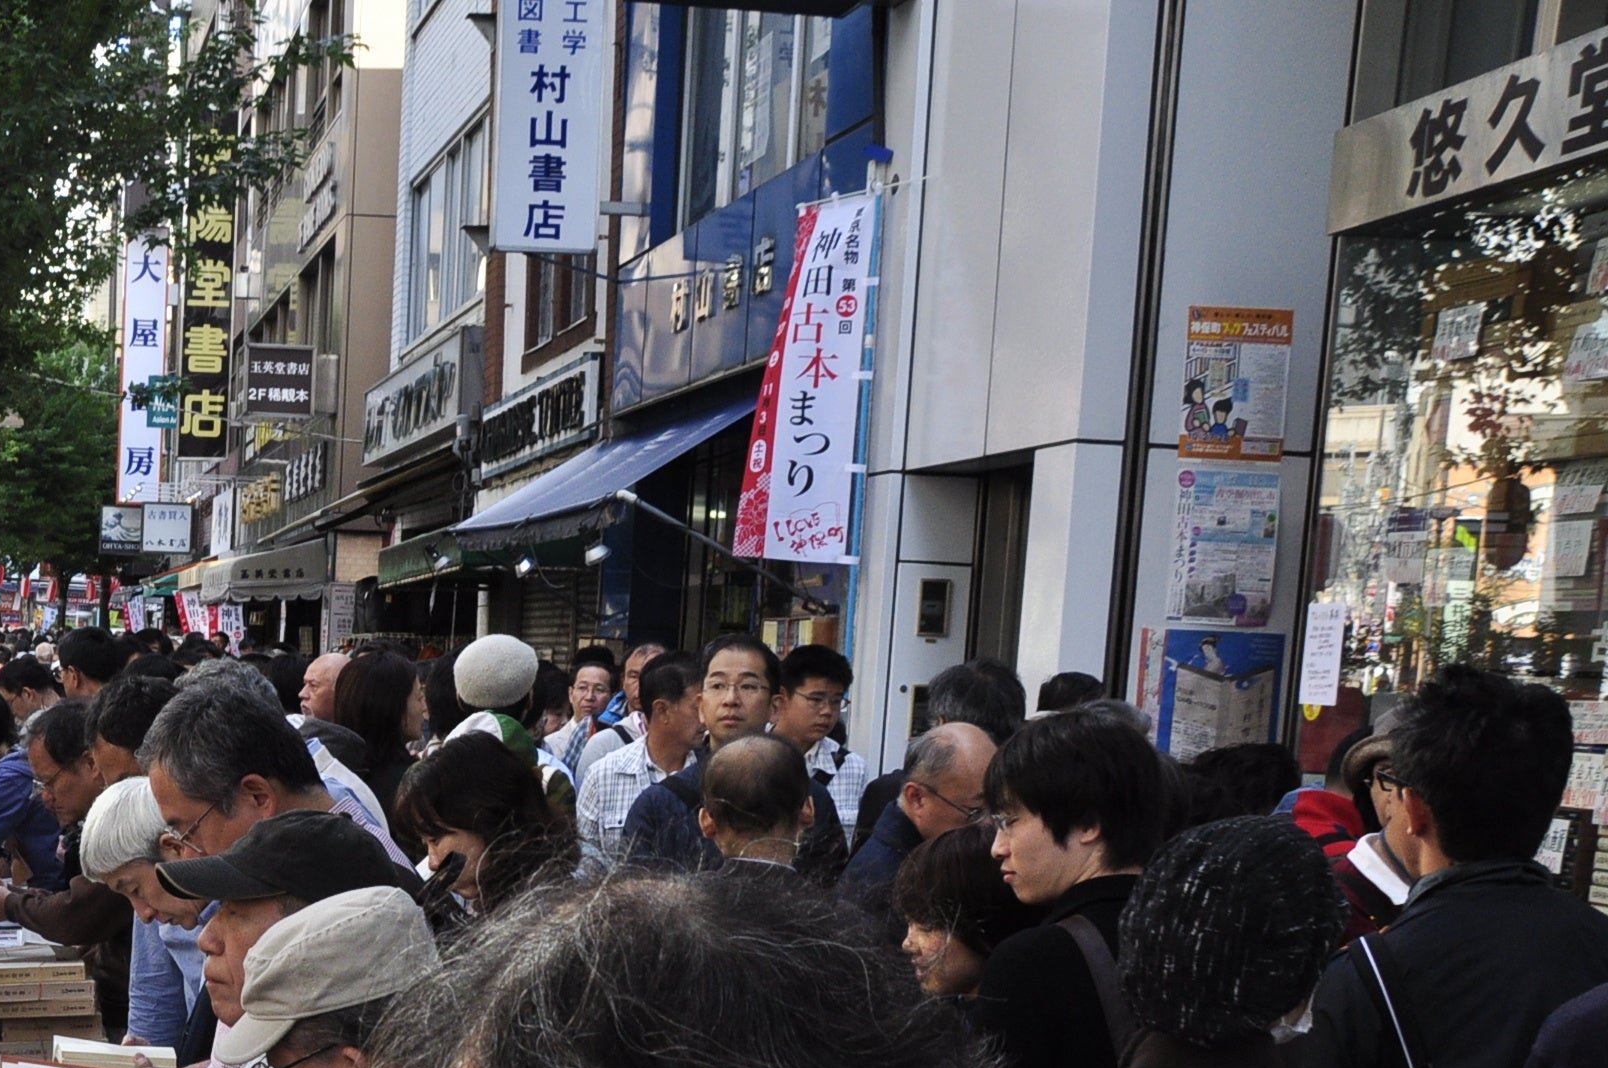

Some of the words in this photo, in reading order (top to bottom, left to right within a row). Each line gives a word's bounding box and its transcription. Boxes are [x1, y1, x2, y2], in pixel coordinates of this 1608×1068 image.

[516, 0, 543, 54] 図書
[524, 63, 570, 240] 村山書店
[250, 361, 310, 376] 玉英堂書店
[787, 227, 841, 497] 神田古本まつり
[248, 388, 266, 401] 2F
[147, 510, 188, 521] 古書買入
